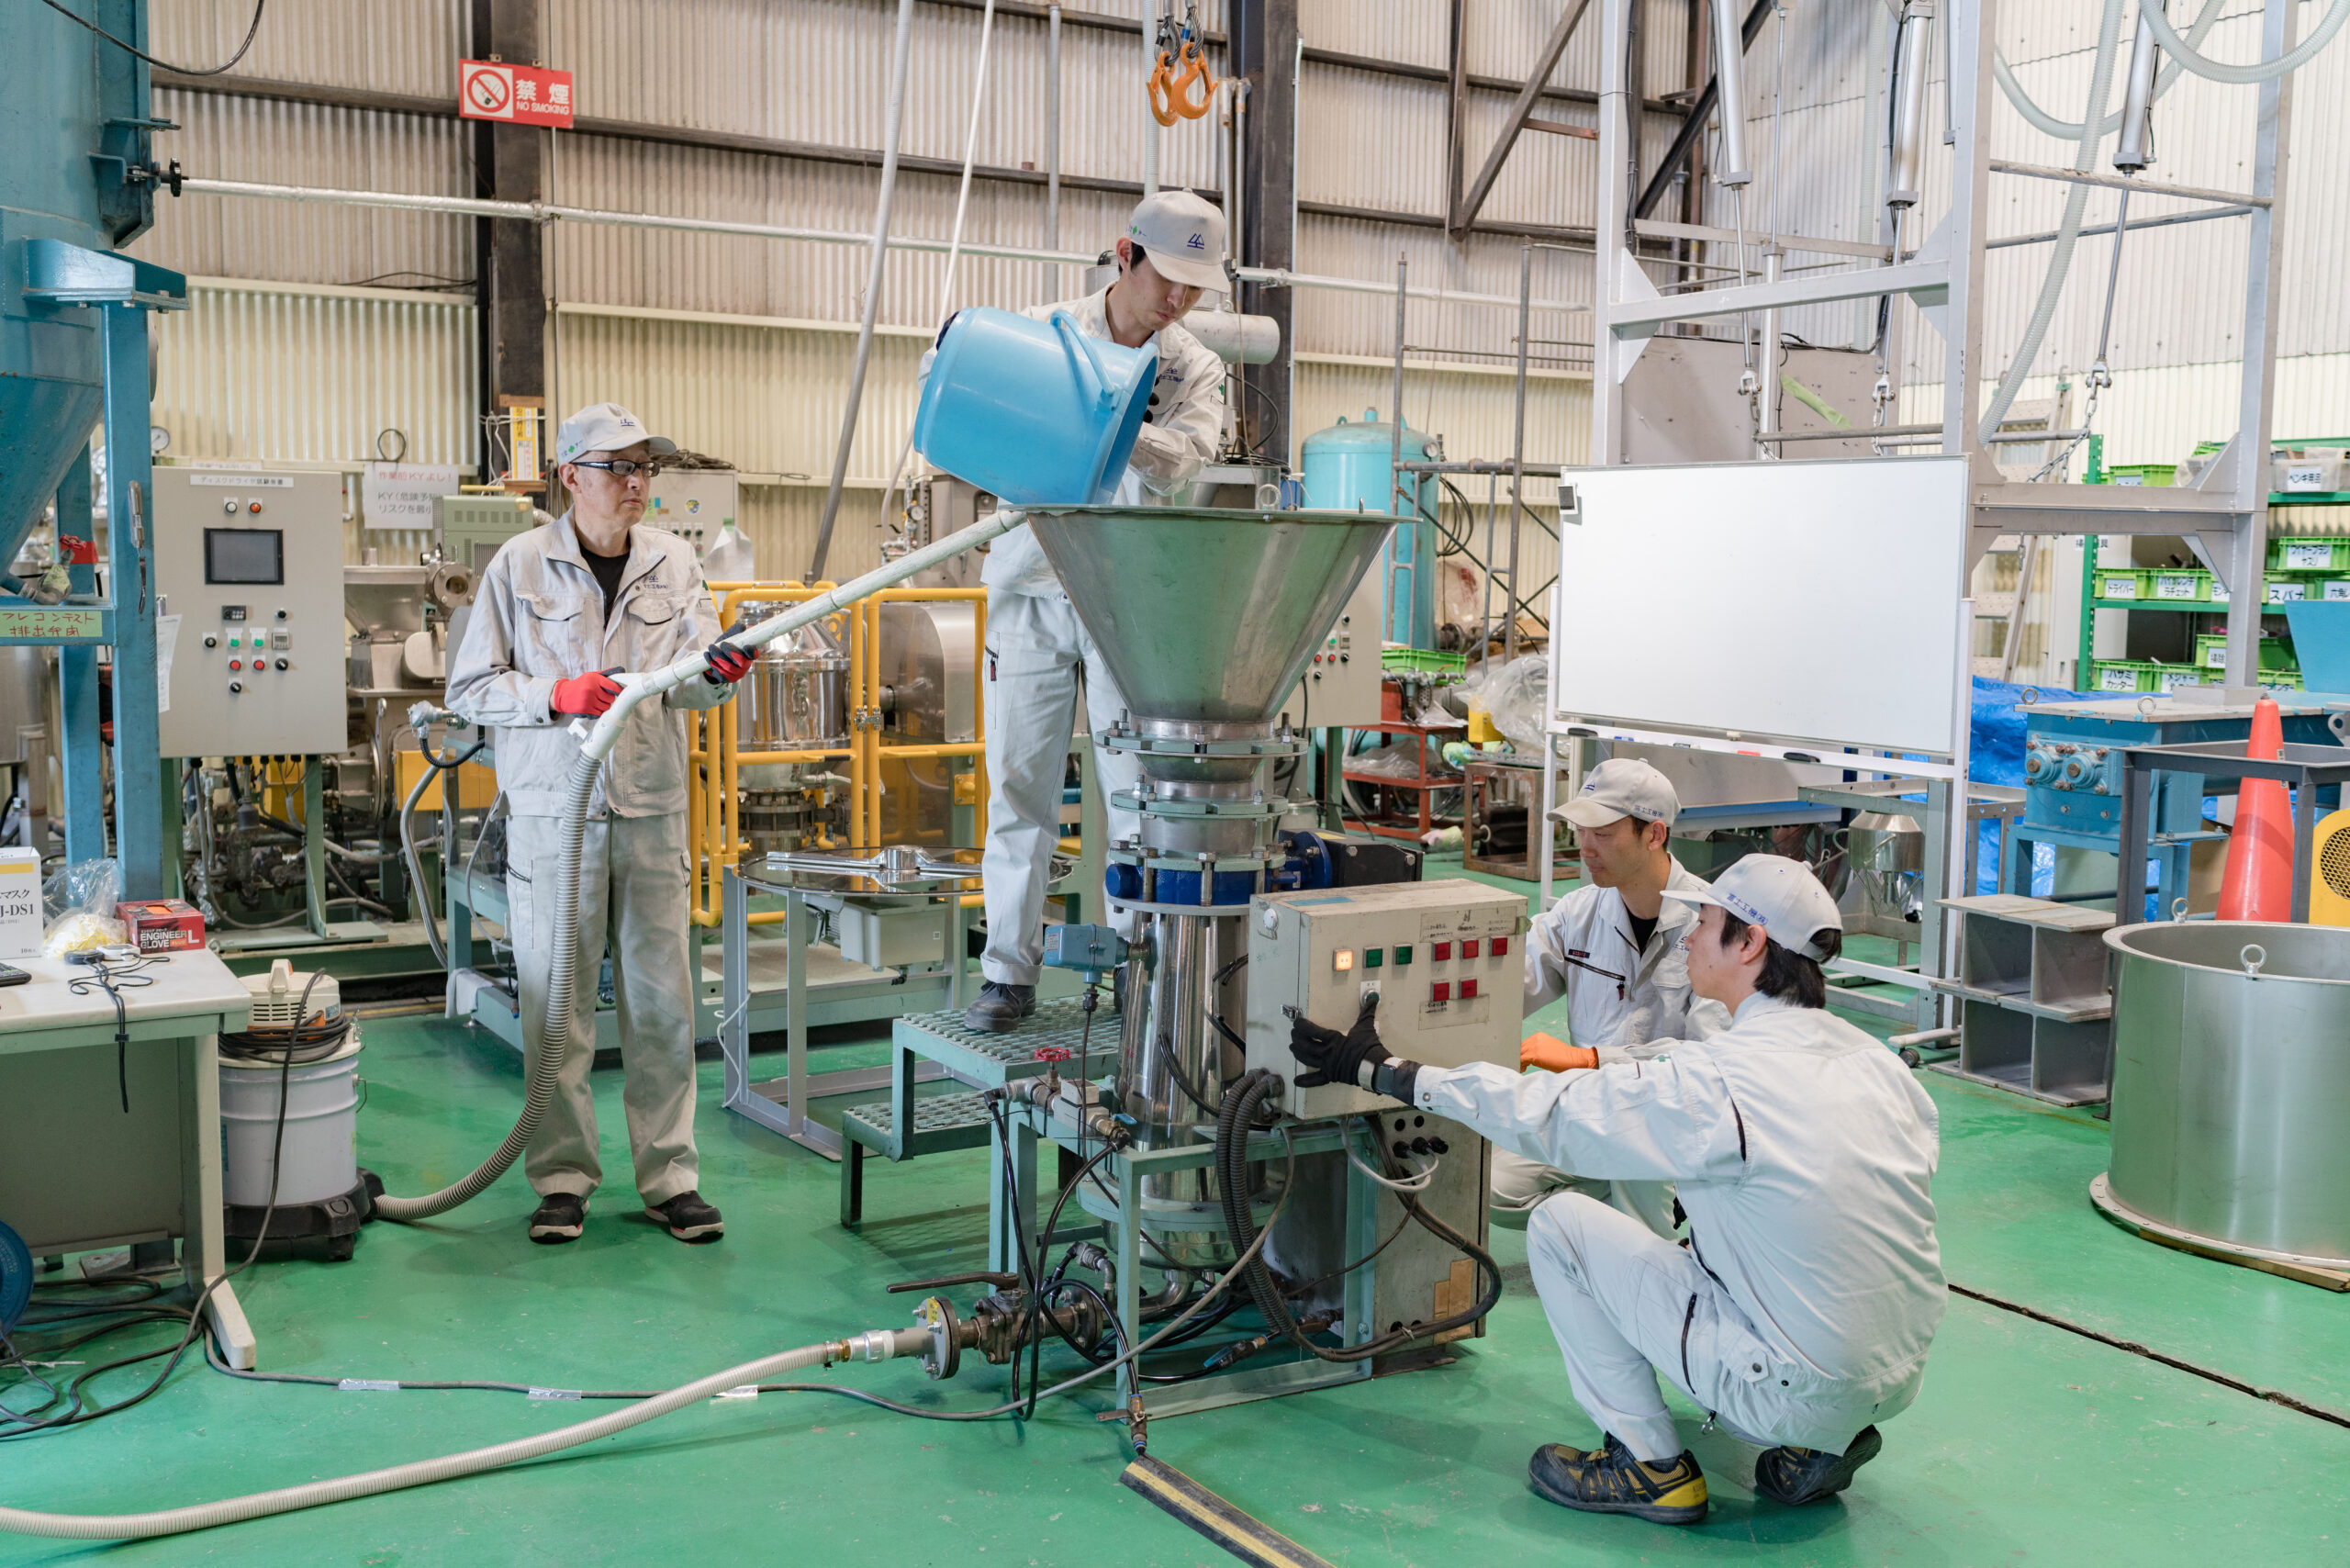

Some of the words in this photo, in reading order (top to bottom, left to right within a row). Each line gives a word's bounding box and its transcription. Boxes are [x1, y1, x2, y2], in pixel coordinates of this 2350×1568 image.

[516, 101, 530, 111] NO
[532, 103, 569, 115] SMOKING
[3, 612, 95, 624] フレコンテスト
[0, 889, 30, 900] マスク
[140, 930, 186, 942] ENGINEER
[188, 930, 199, 944] L
[140, 939, 170, 949] GLOVE
